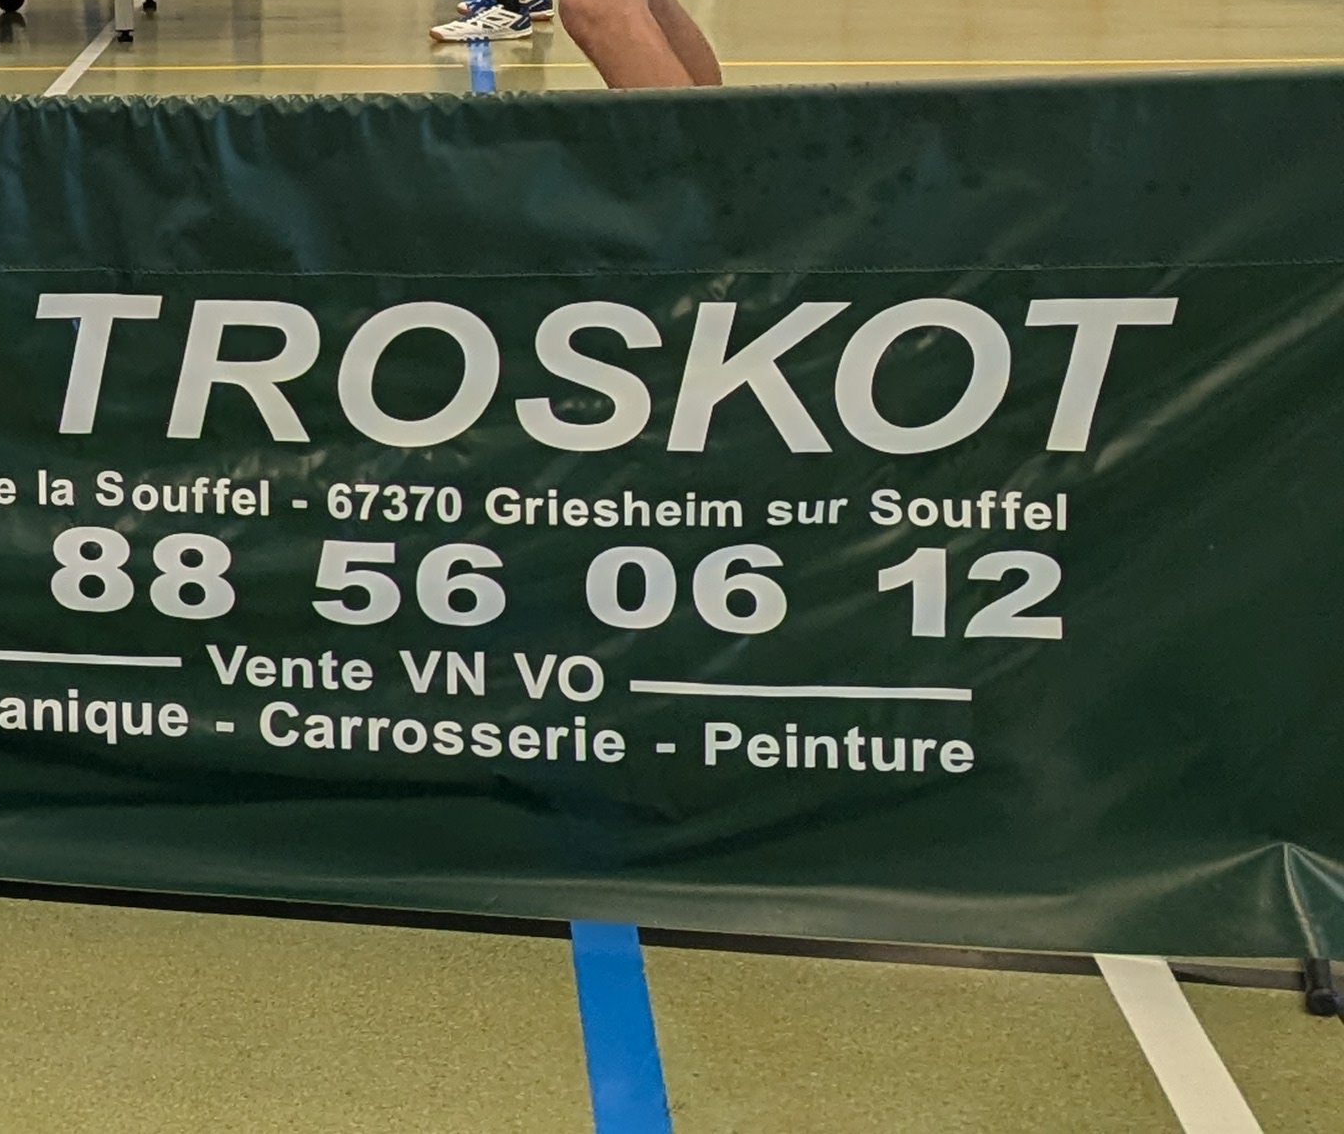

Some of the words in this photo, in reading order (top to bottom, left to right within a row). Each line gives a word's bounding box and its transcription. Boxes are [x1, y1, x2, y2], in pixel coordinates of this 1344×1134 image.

[36, 294, 1178, 454] TROSKOT
[39, 470, 75, 506] la
[96, 471, 269, 517] Souffel
[328, 483, 462, 523] 67370
[486, 487, 743, 528] Griesheim
[767, 499, 849, 526] sur
[870, 489, 1067, 531] Souffel
[51, 527, 236, 620] 88
[313, 540, 506, 627] 56
[586, 544, 788, 635] 06
[879, 548, 1063, 640] 12
[207, 645, 373, 691] Vente
[400, 651, 485, 696] VN
[514, 653, 604, 702] VO
[216, 722, 235, 733] -
[260, 702, 626, 763] Carrosserie
[655, 743, 676, 754] -
[705, 723, 975, 773] Peinture
